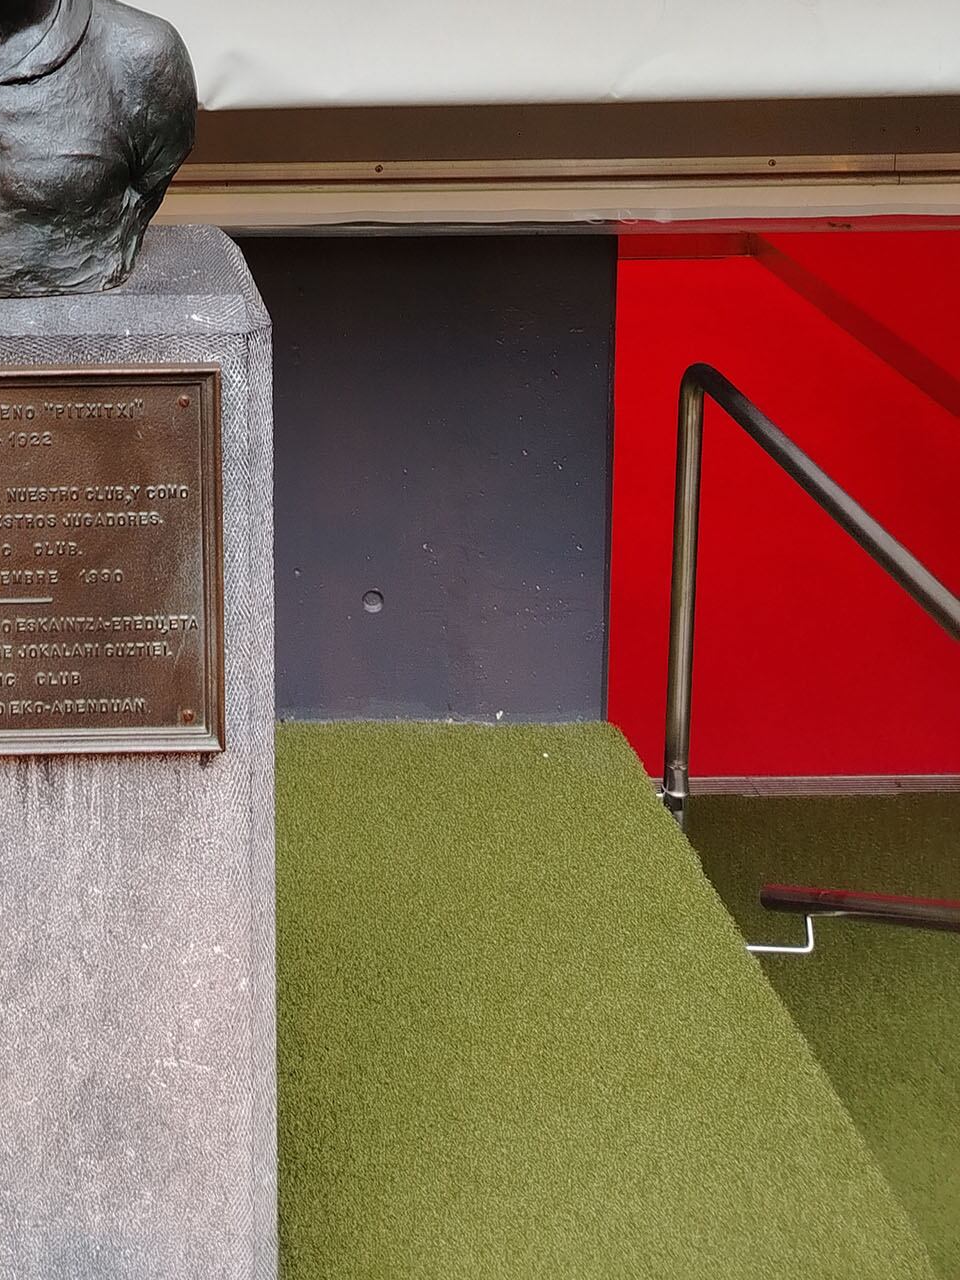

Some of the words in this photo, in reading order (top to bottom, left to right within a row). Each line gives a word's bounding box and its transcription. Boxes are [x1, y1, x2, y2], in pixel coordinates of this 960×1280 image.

[7, 486, 80, 503] NUESTRO
[145, 483, 189, 500] COMO
[62, 511, 164, 528] JUGADORES.
[33, 541, 84, 557] CLUB.
[79, 569, 124, 585] 1990
[18, 642, 99, 659] JOKALARI
[36, 671, 81, 687] CLUB
